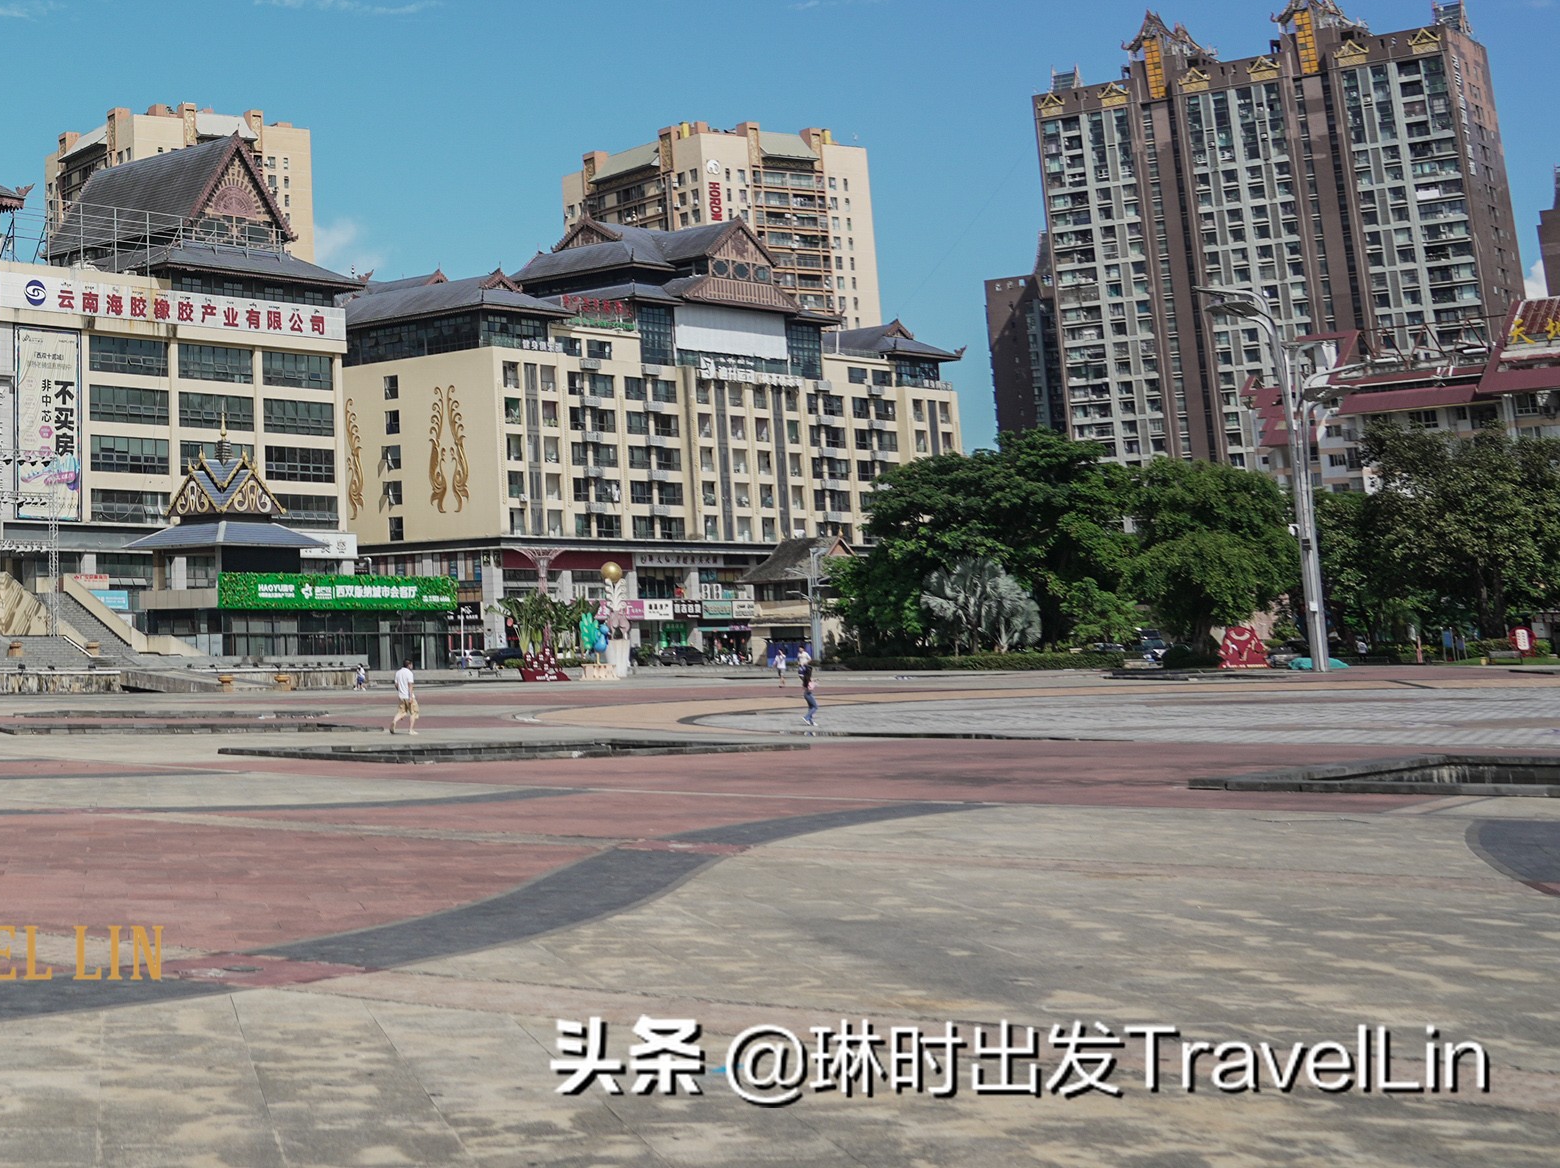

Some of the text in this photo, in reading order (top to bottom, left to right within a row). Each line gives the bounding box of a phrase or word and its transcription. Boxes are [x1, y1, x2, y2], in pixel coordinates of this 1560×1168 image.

[708, 181, 723, 222] HORON
[57, 289, 326, 335] 云南海胶橡胶产业有限公司
[41, 379, 52, 423] 非中芯
[54, 380, 75, 457] 不买房
